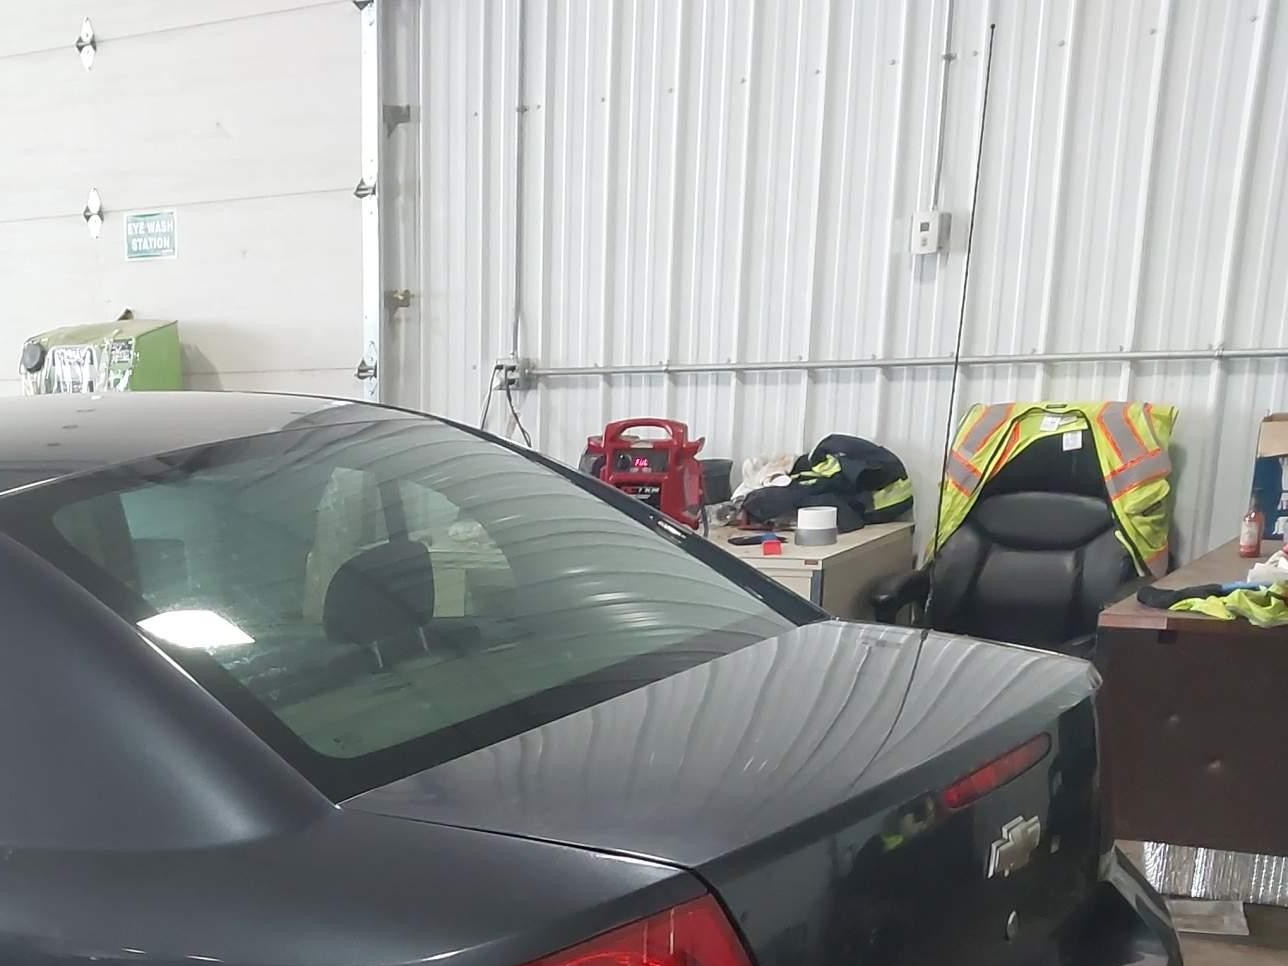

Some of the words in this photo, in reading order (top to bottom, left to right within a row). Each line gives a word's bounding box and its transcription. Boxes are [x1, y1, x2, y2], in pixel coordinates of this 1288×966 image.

[127, 221, 145, 235] EYE
[147, 219, 174, 233] WASH
[132, 236, 170, 251] STATION
